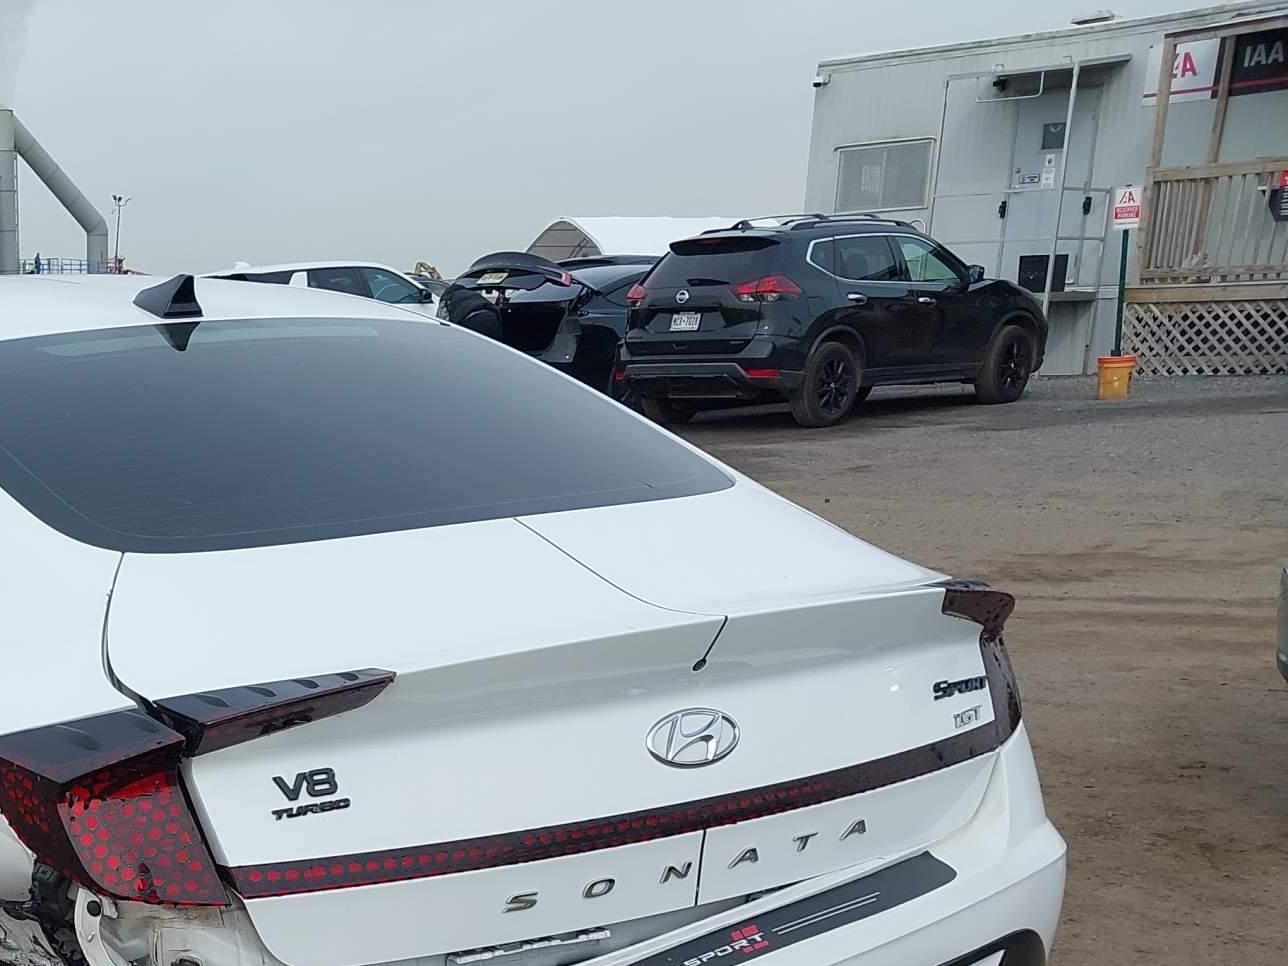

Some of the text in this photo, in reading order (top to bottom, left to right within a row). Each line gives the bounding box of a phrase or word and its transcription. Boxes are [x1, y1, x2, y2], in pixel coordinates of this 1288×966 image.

[1243, 40, 1284, 68] IAA
[271, 767, 339, 802] V8
[271, 798, 351, 821] TURBO
[502, 818, 867, 914] SONATA
